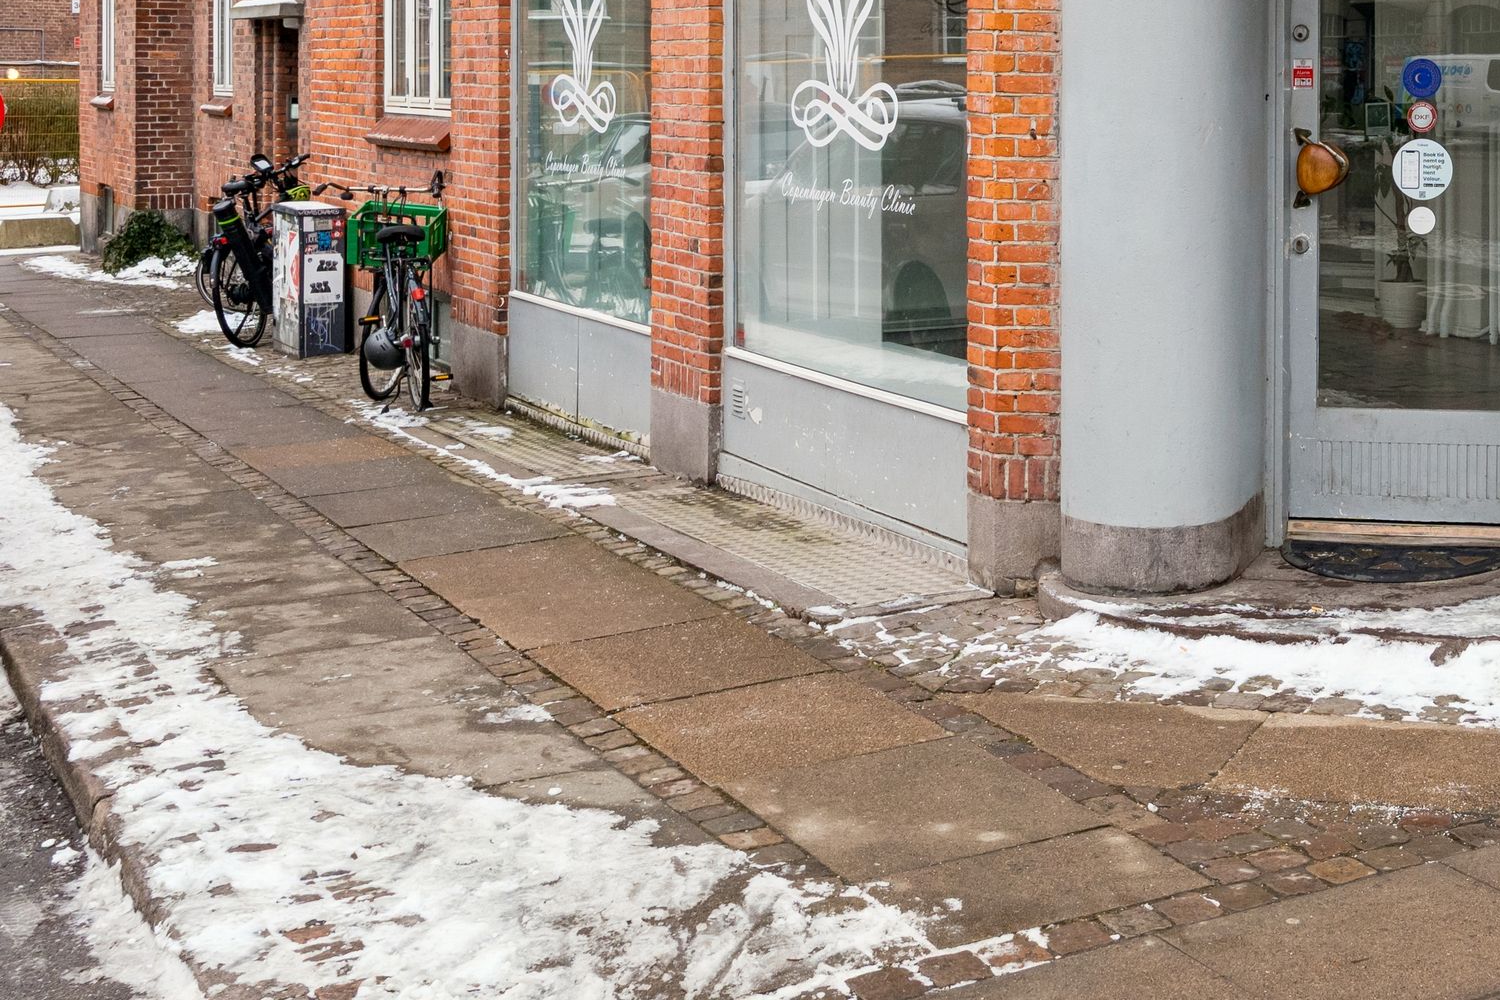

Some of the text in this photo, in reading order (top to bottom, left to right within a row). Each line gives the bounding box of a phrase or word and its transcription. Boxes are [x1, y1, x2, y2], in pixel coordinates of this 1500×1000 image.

[545, 151, 626, 185] Copenhagen Beauty Clinic
[781, 172, 916, 219] Copenhagen Beauty Clinic
